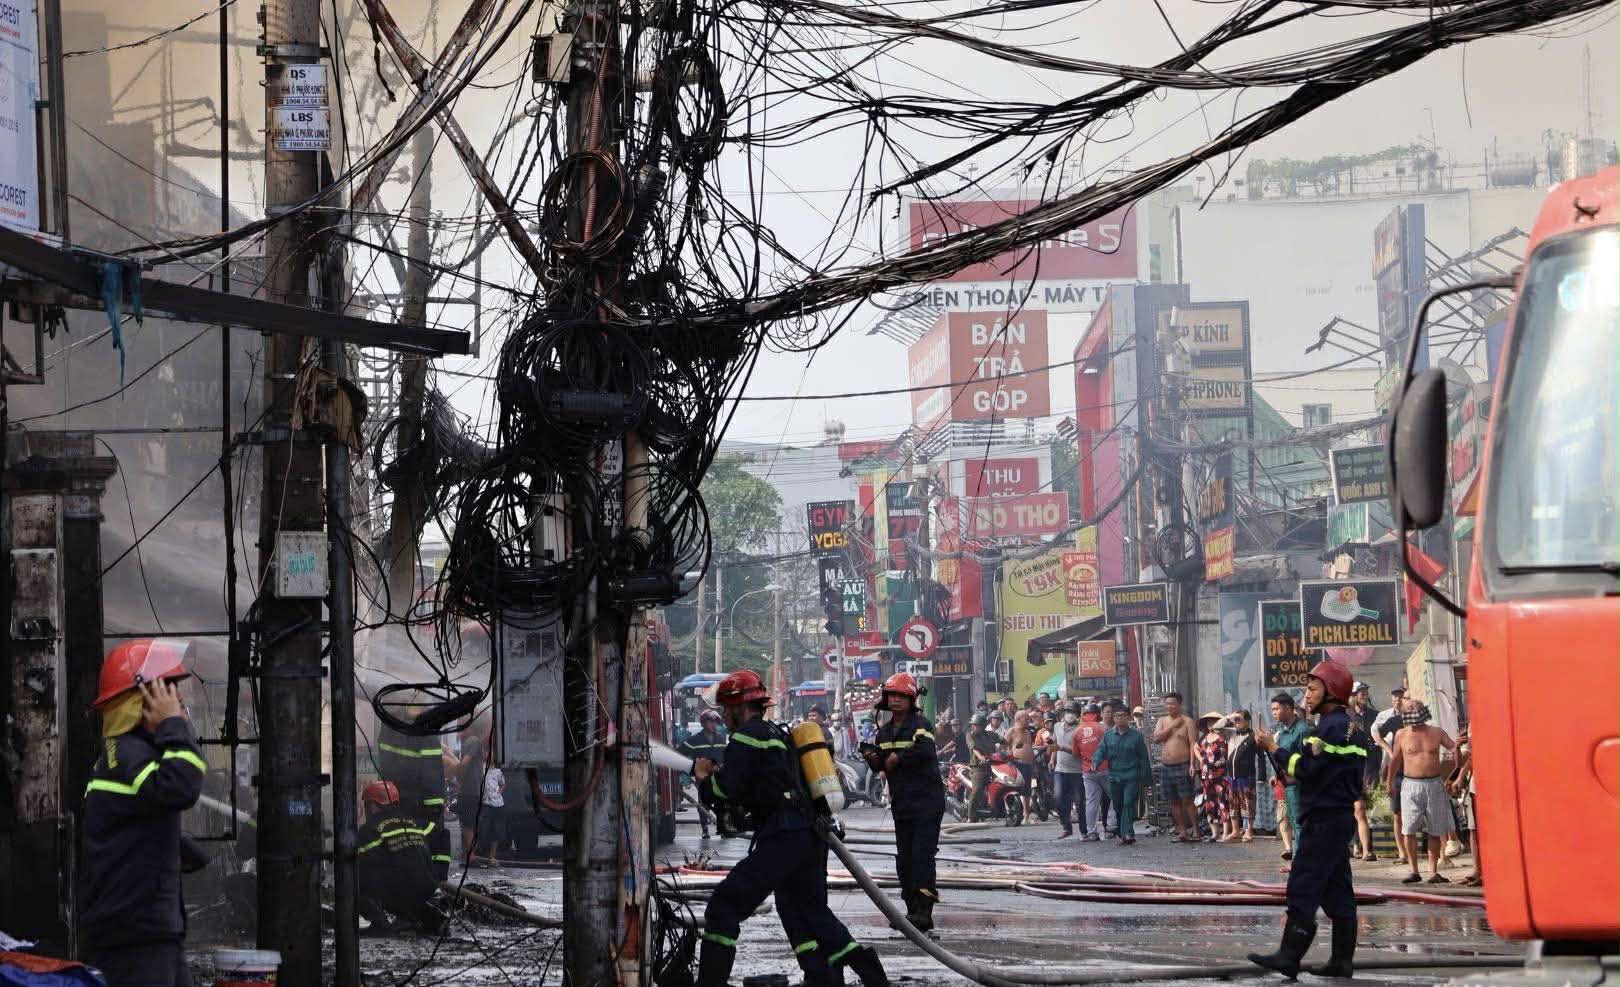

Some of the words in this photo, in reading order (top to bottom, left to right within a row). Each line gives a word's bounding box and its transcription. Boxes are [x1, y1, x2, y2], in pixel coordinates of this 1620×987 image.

[291, 112, 313, 122] LBS
[1045, 282, 1086, 304] MÁY
[971, 317, 1026, 345] BÁN
[1193, 320, 1229, 342] KÍNH
[973, 349, 1026, 379] TRẢ
[984, 467, 1021, 485] THU
[842, 583, 864, 596] AU
[1023, 567, 1063, 594] 19K
[1109, 589, 1162, 605] KINGDOM
[1004, 613, 1035, 631] SIÊU
[1310, 624, 1393, 643] PICKLEBALL
[1266, 633, 1288, 657] ĐỒ
[1280, 661, 1308, 672] GYM
[1280, 674, 1310, 685] YOG
